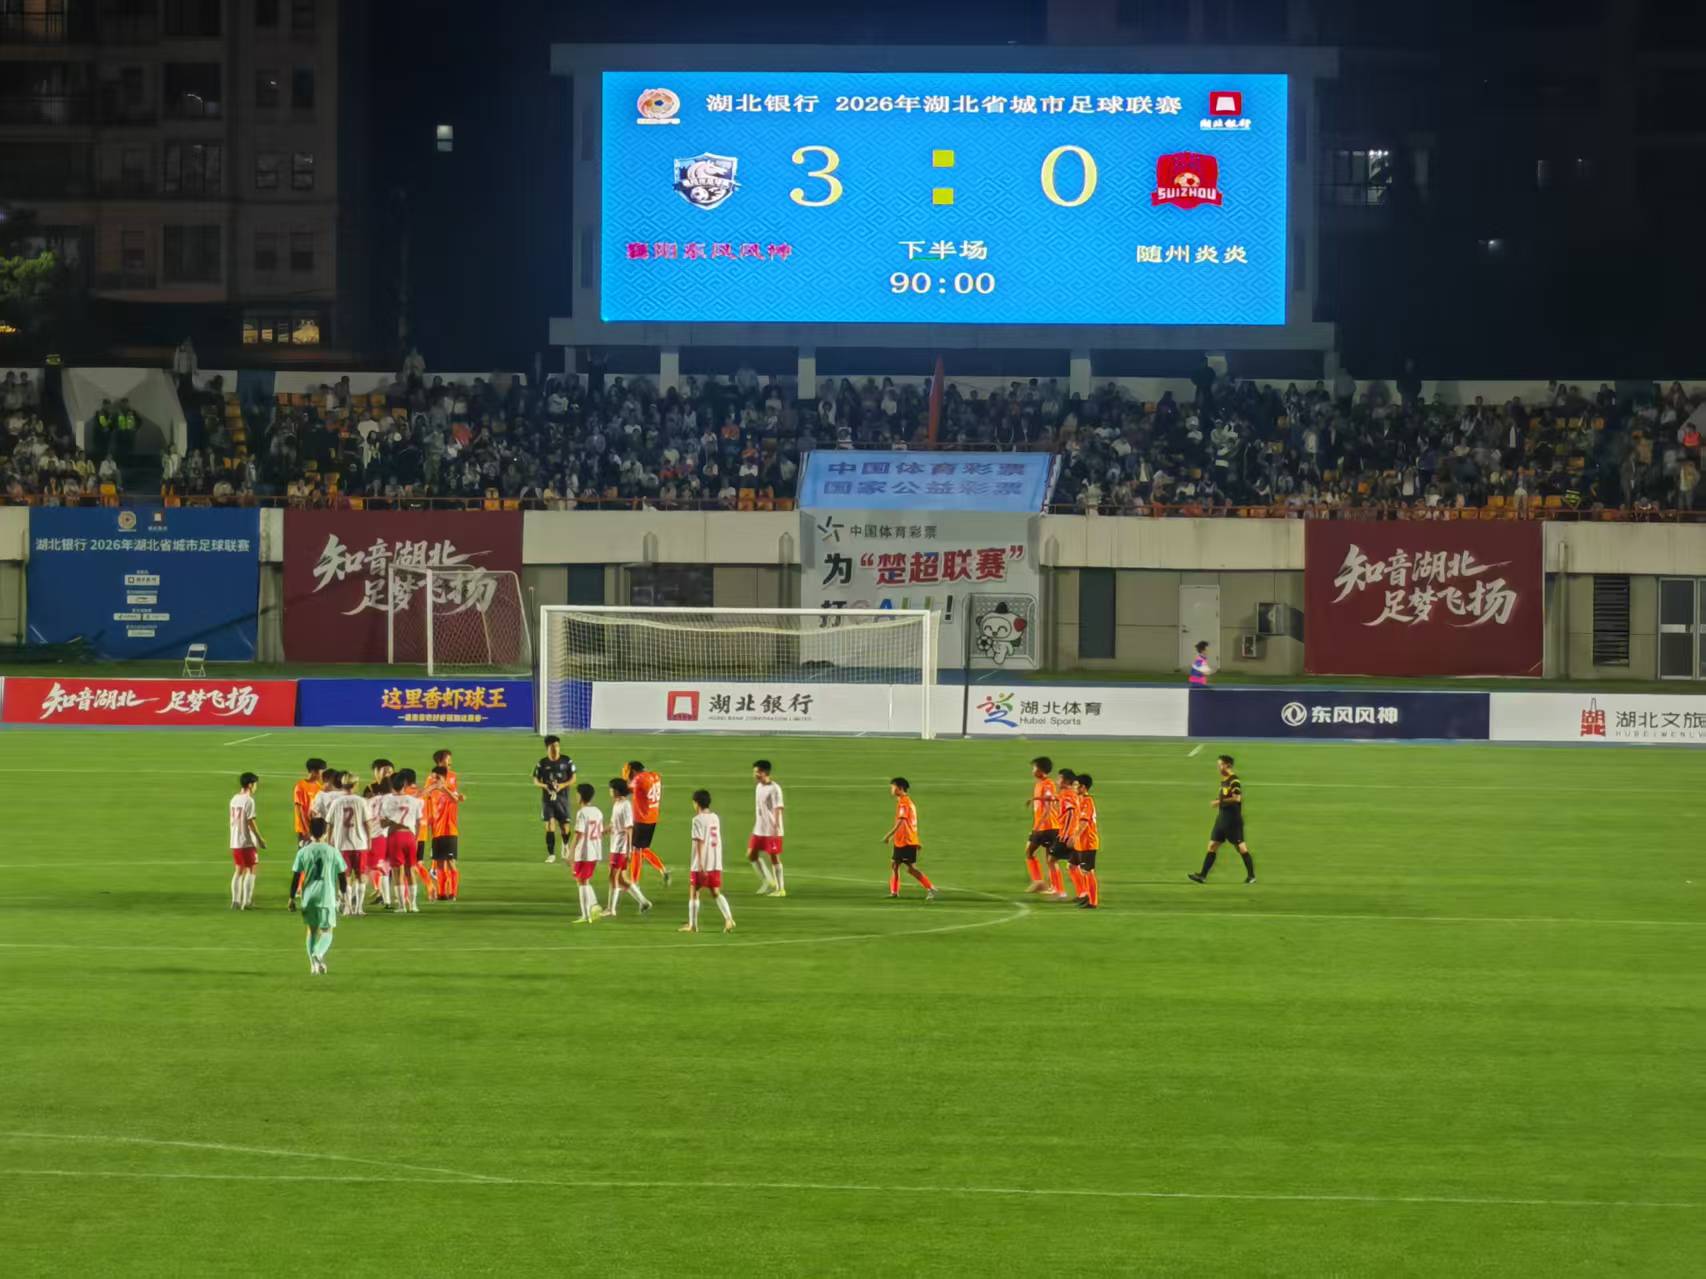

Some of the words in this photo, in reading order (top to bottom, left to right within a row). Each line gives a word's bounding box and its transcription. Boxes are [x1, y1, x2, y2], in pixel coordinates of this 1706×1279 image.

[706, 94, 819, 113] 湖北银行
[835, 94, 1183, 115] 2026年湖北省城市足球联赛
[789, 145, 843, 207] 3
[1040, 145, 1098, 207] 0
[1158, 187, 1217, 200] SUIZHOU
[898, 240, 988, 260] 下半场
[1136, 244, 1249, 264] 随州炎炎
[889, 272, 996, 294] 90:00
[827, 462, 1025, 476] 中国体育彩票
[823, 480, 1024, 496] 国家公益彩票
[850, 524, 937, 539] 中国体育彩票
[312, 533, 493, 593] 知音湖北
[1332, 544, 1513, 603] 知音湖北
[1360, 578, 1518, 627] 足梦飞扬
[39, 682, 160, 720] 知音湖北
[154, 686, 260, 717] 足梦飞扬
[381, 686, 507, 710] 这里香虾球王
[1020, 700, 1103, 716] 湖北体育
[1311, 706, 1399, 724] 东风风神
[1616, 711, 1706, 729] 湖北文旅
[399, 806, 410, 824] 7
